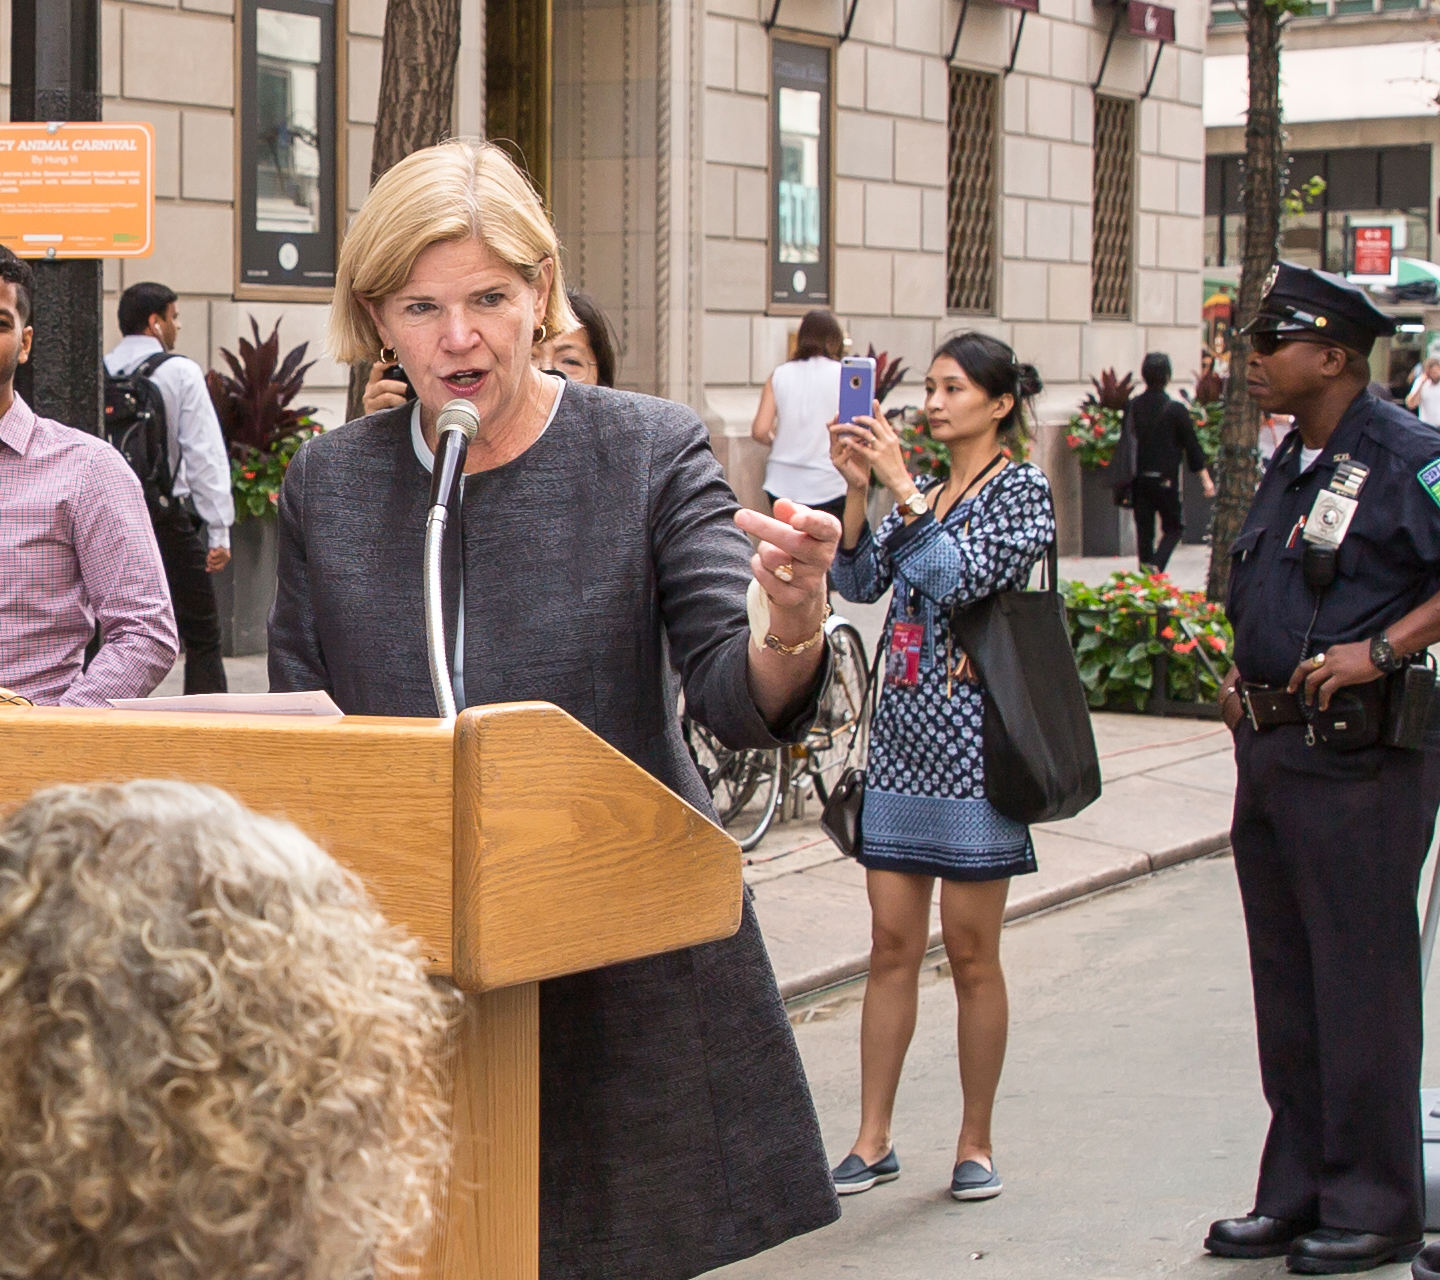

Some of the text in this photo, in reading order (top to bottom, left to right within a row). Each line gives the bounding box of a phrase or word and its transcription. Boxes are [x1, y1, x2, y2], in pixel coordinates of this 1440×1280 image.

[17, 139, 69, 151] ANIMAL
[72, 139, 137, 151] CARNIVAL
[31, 155, 43, 165] By
[44, 155, 69, 165] Hung
